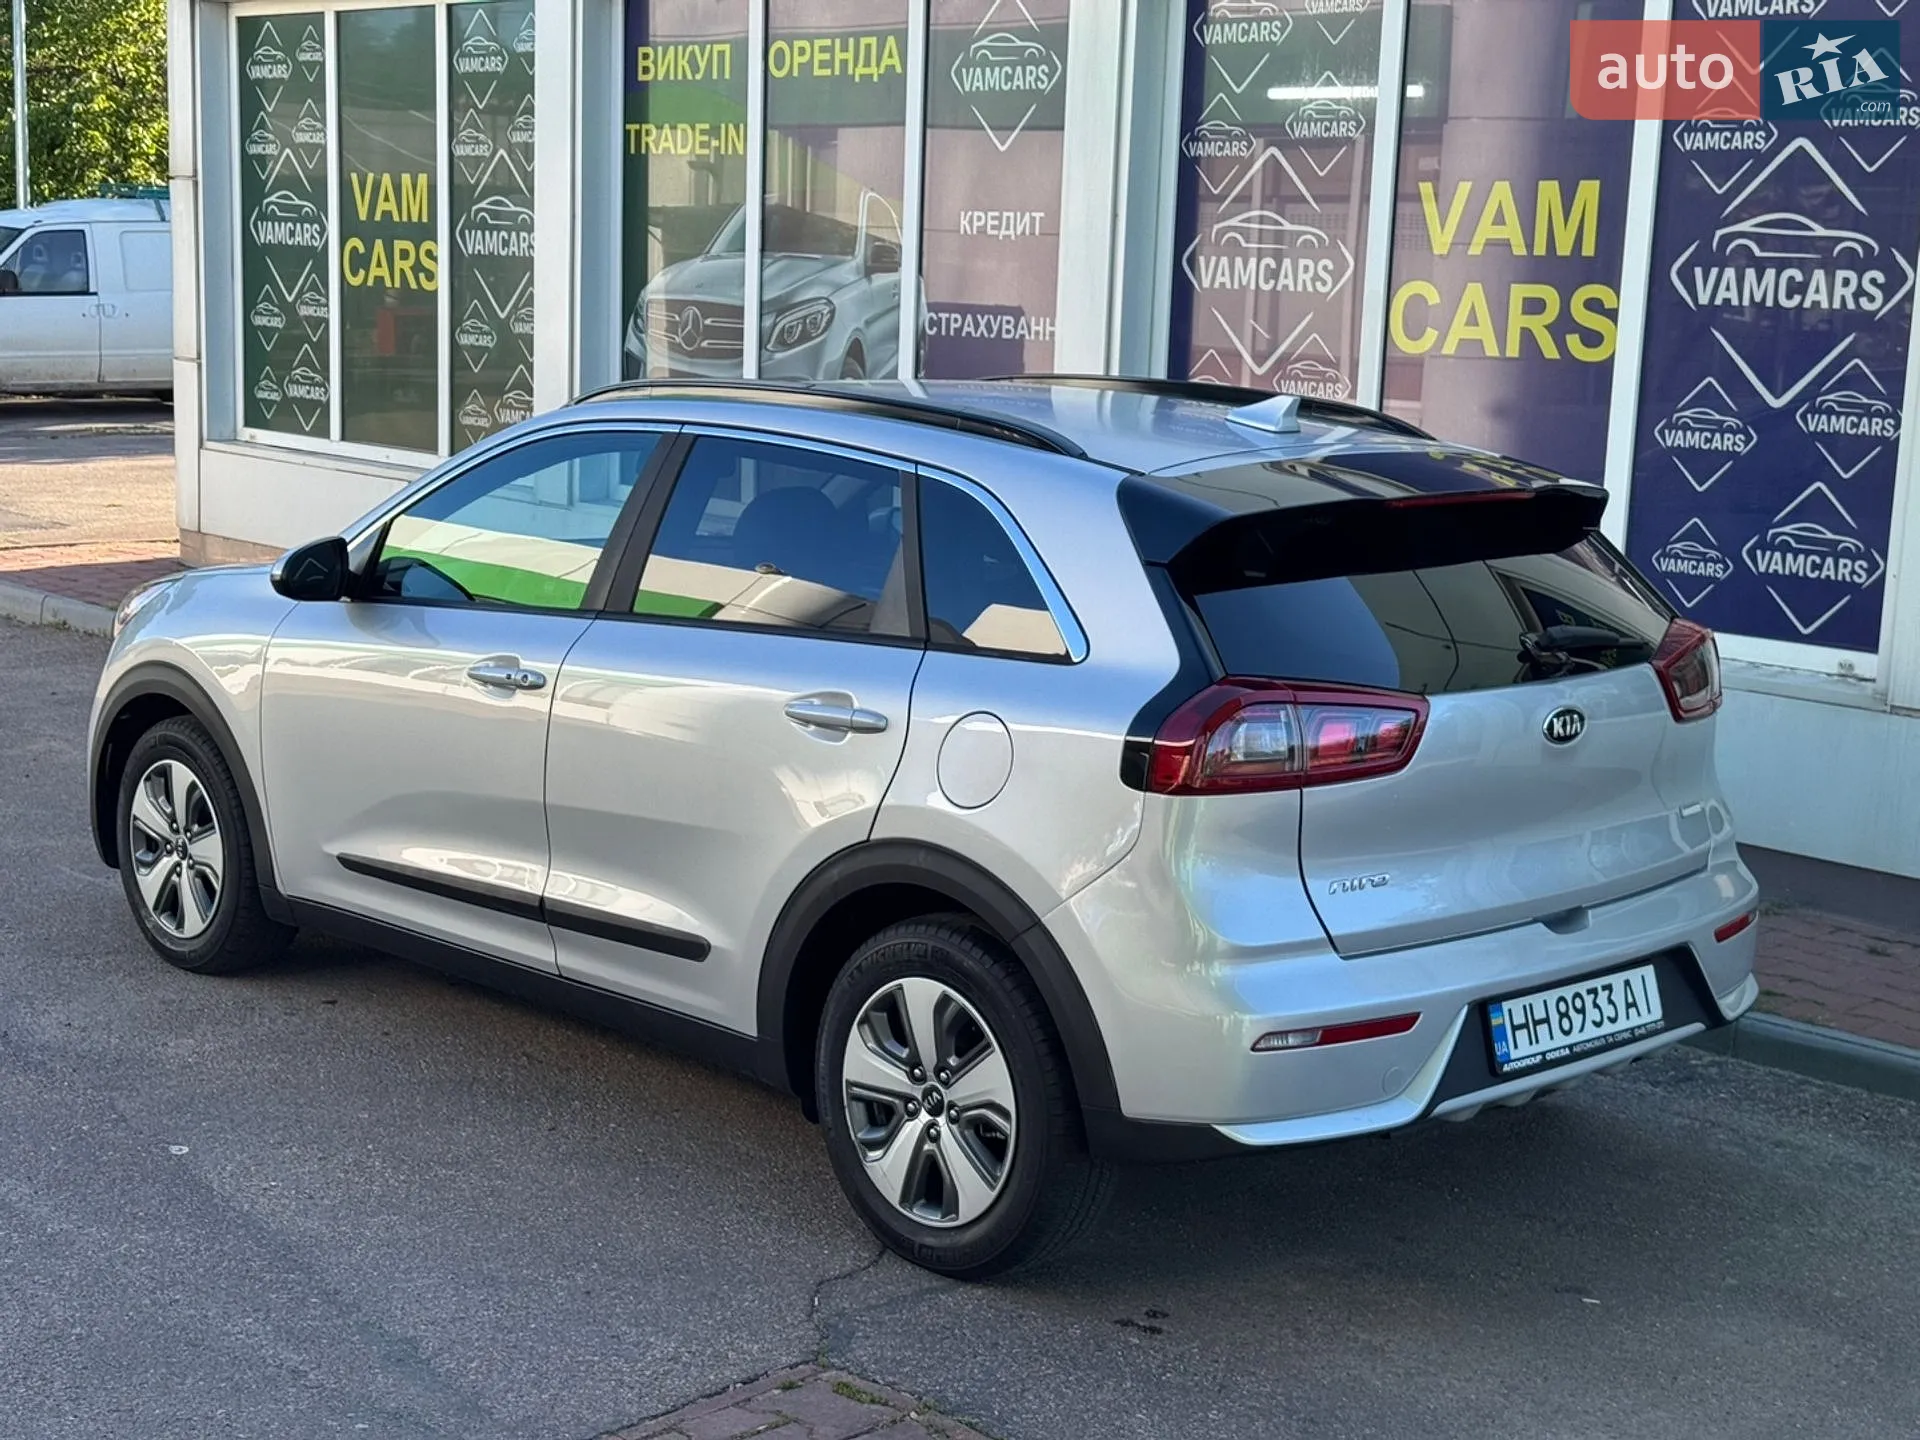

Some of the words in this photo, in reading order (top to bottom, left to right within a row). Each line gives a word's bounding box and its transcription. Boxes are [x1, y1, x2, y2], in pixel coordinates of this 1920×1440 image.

[1311, 0, 1364, 14] VAMCARS
[1706, 0, 1816, 18] VAMCARS
[1203, 21, 1283, 45] VAMCARS
[250, 63, 288, 80] VAMCARS
[458, 55, 502, 73] VAMCARS
[637, 43, 731, 82] ВИКУП
[768, 36, 903, 82] ОРЕНДА
[961, 63, 1050, 93] VAMCARS
[626, 123, 745, 156] TRADE-IN
[1293, 121, 1358, 139] VAMCARS
[1683, 130, 1767, 150] VAMCARS
[1189, 140, 1249, 158] VAMCARS
[350, 173, 429, 224] VAM
[959, 210, 1047, 241] КРЕДИТ
[1418, 179, 1601, 258] VAM
[257, 221, 321, 248] VAMCARS
[342, 237, 439, 292] CARS
[1198, 255, 1335, 293] VAMCARS
[1693, 265, 1887, 312] VAMCARS
[1388, 280, 1619, 363] CARS
[288, 383, 325, 402] VAMCARS
[1281, 379, 1343, 400] VAMCARS
[1806, 412, 1896, 439] VAMCARS
[1664, 427, 1747, 453] VAMCARS
[1659, 556, 1726, 580] VAMCARS
[1754, 548, 1870, 585] VAMCARS
[1553, 714, 1581, 739] KIA
